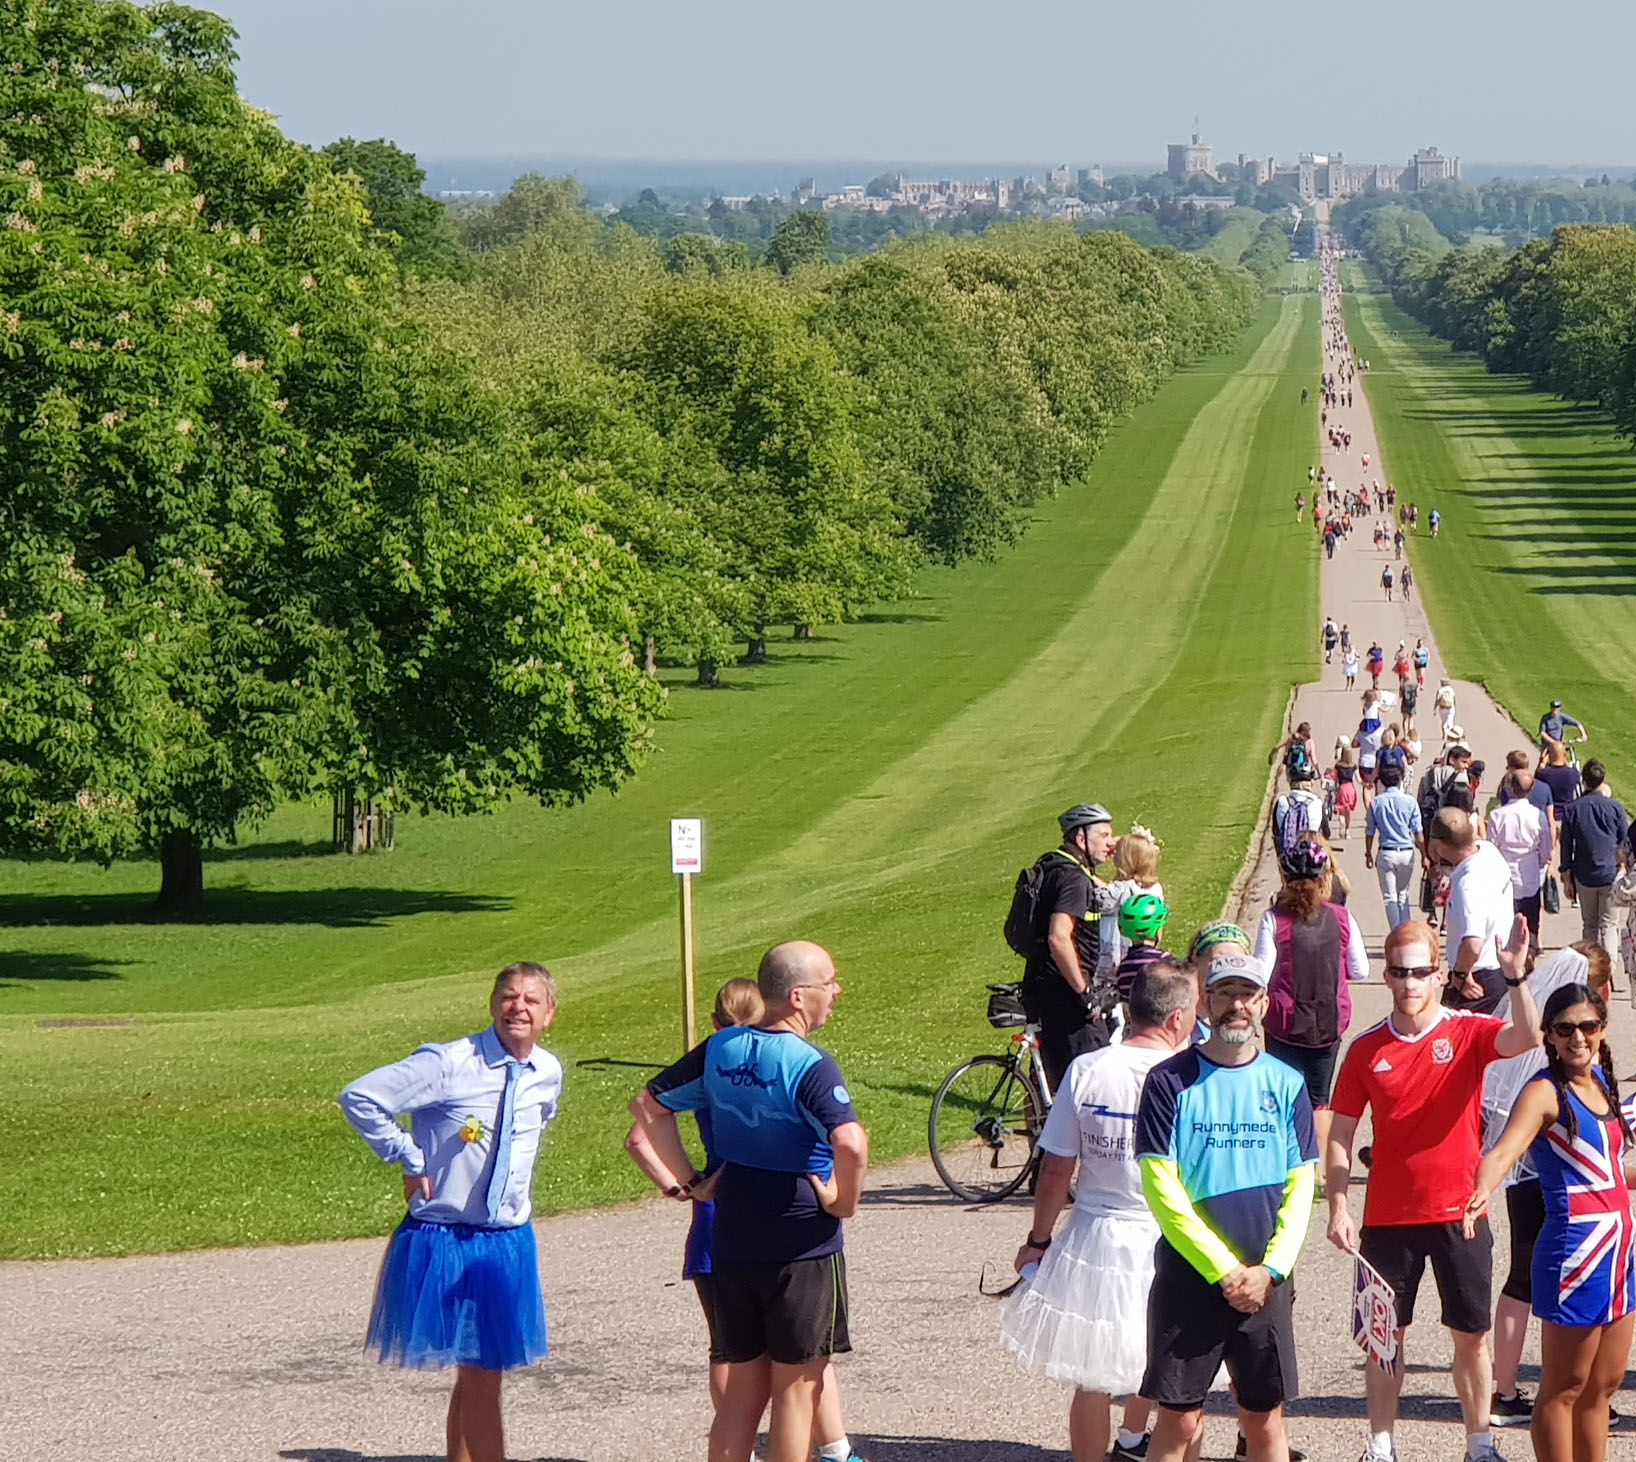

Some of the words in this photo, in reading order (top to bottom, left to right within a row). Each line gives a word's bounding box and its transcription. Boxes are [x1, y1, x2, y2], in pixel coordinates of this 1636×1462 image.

[1192, 1121, 1277, 1135] Runnymede
[1205, 1137, 1266, 1149] Runners
[1373, 1298, 1387, 1343] OK!
